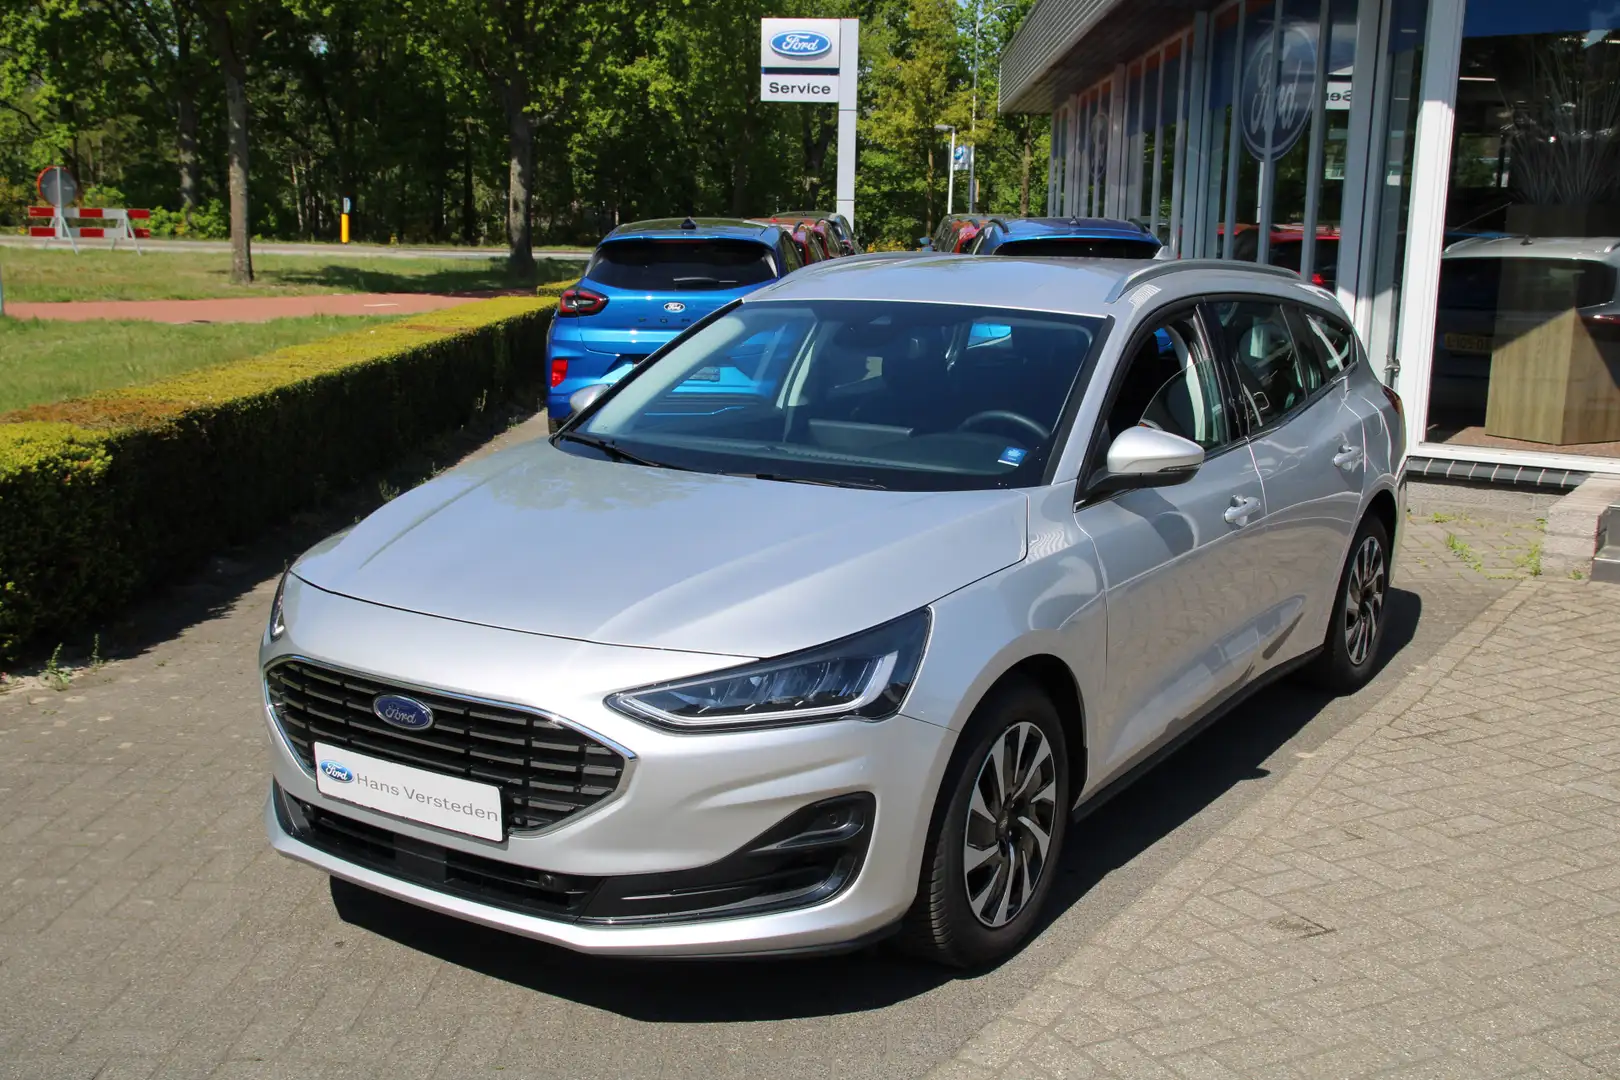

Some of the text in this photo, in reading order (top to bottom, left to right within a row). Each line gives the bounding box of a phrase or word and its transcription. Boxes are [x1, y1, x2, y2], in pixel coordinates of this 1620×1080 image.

[781, 34, 820, 51] Ford
[769, 82, 831, 95] Service
[385, 702, 418, 724] Ford
[324, 762, 499, 822] Ford Hans Versteden
